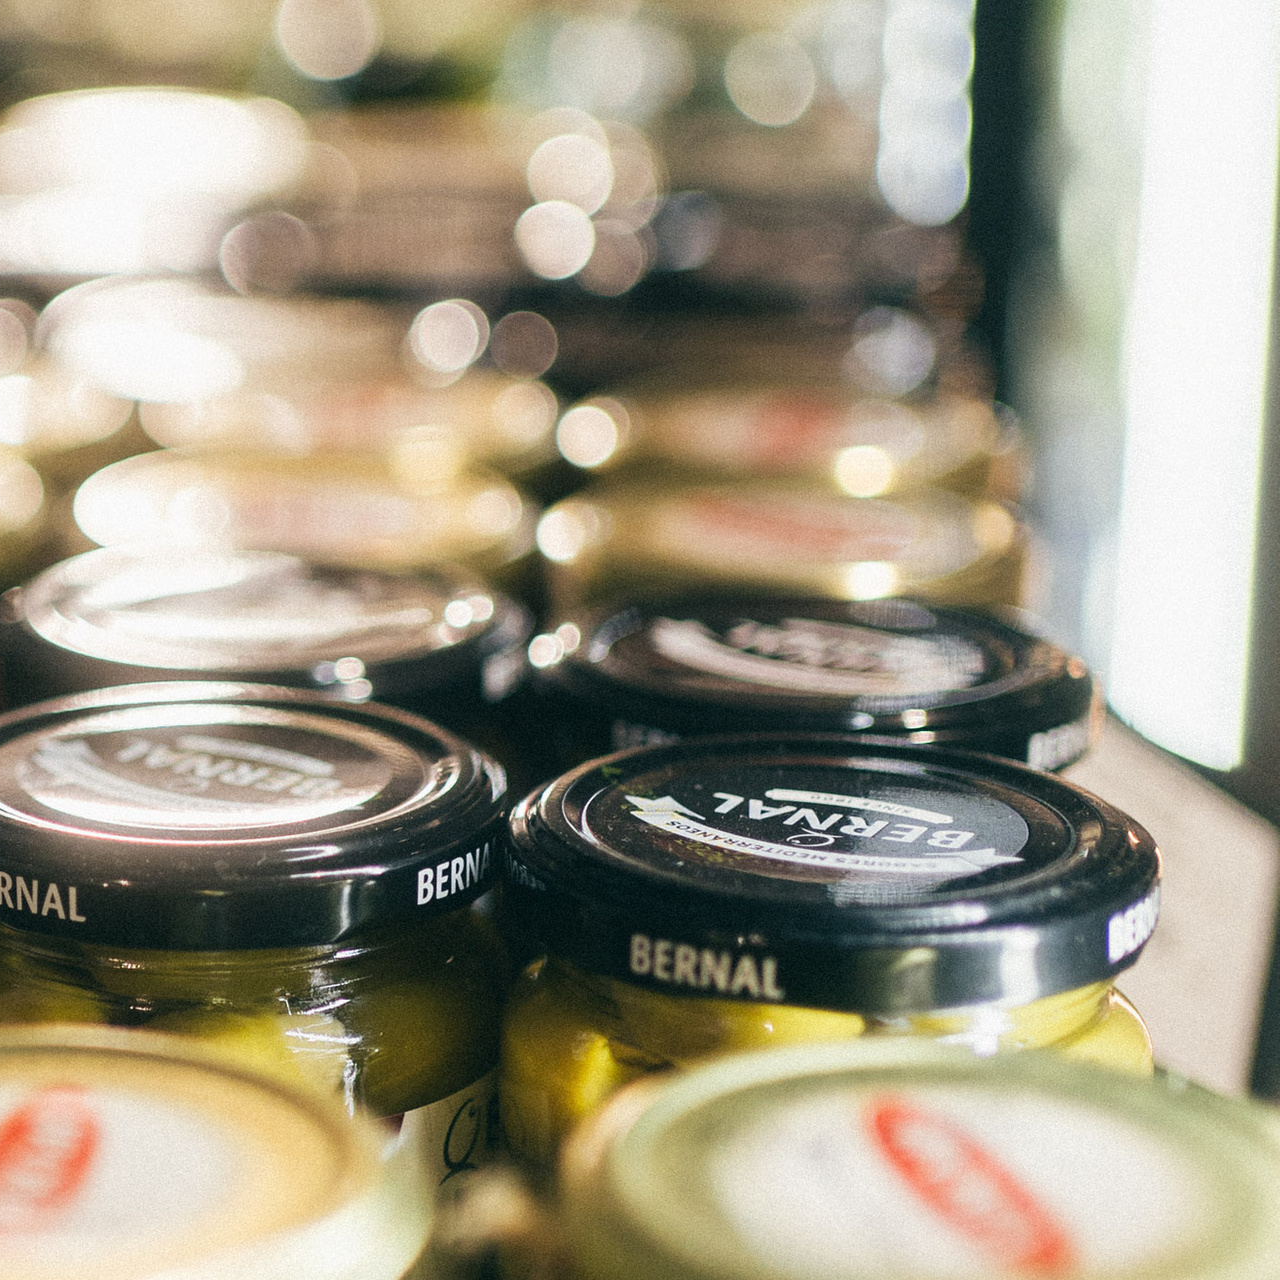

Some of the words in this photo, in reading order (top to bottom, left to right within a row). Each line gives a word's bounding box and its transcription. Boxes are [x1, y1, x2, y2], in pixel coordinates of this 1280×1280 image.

[713, 791, 976, 850] BERNAL
[417, 837, 496, 906] BERNA
[630, 933, 785, 1000] BERNAL
